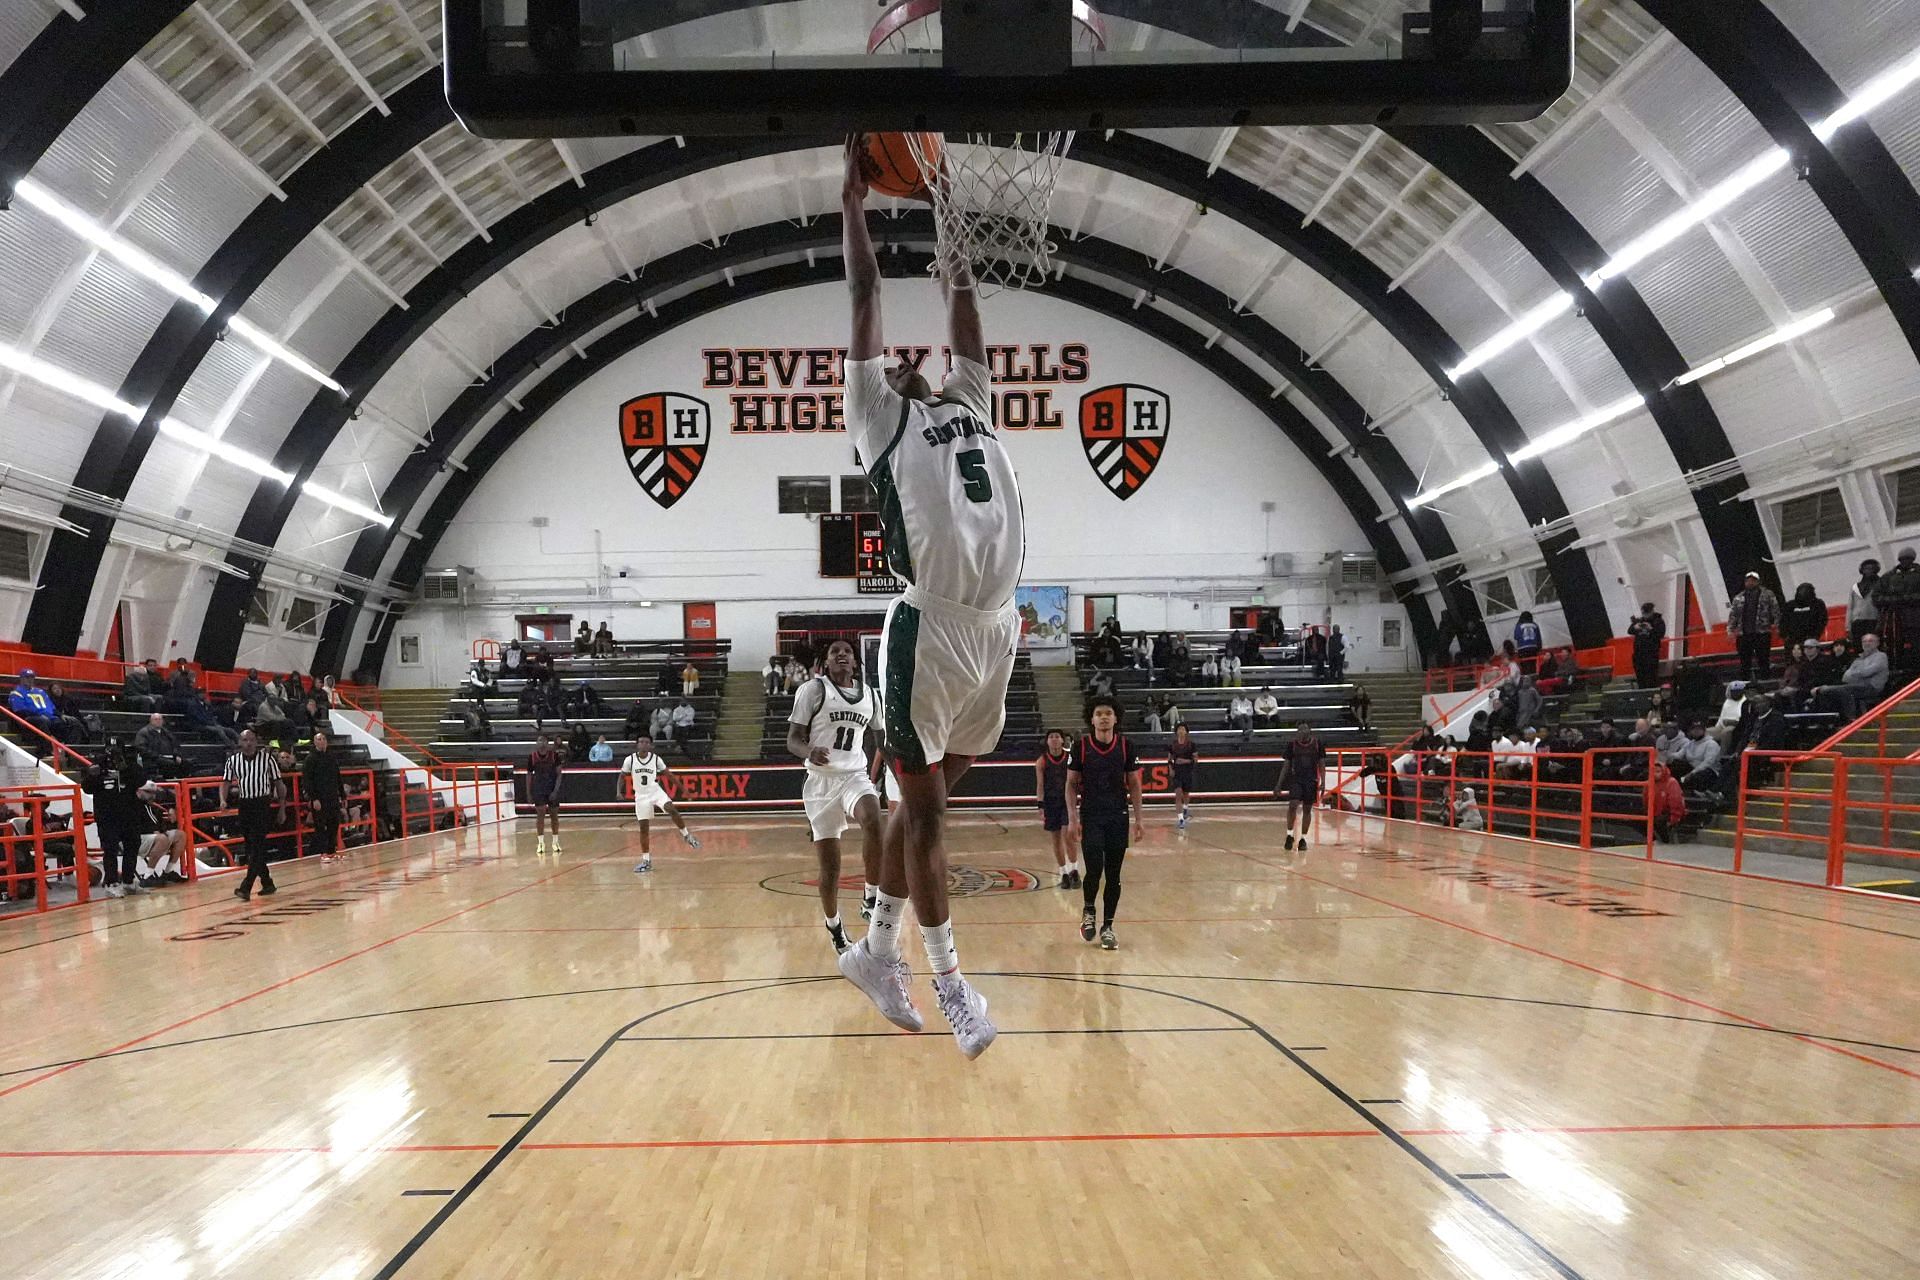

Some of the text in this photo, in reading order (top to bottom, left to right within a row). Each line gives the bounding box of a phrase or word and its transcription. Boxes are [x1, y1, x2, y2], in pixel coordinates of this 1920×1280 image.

[702, 343, 1090, 388] BEVEY ILLS
[632, 409, 699, 439] B H
[1092, 401, 1114, 431] B
[1133, 401, 1159, 430] H
[956, 449, 993, 503] 5
[863, 538, 882, 552] 61
[860, 578, 894, 587] HAROLD
[833, 726, 855, 751] 11
[624, 774, 750, 800] VERLY
